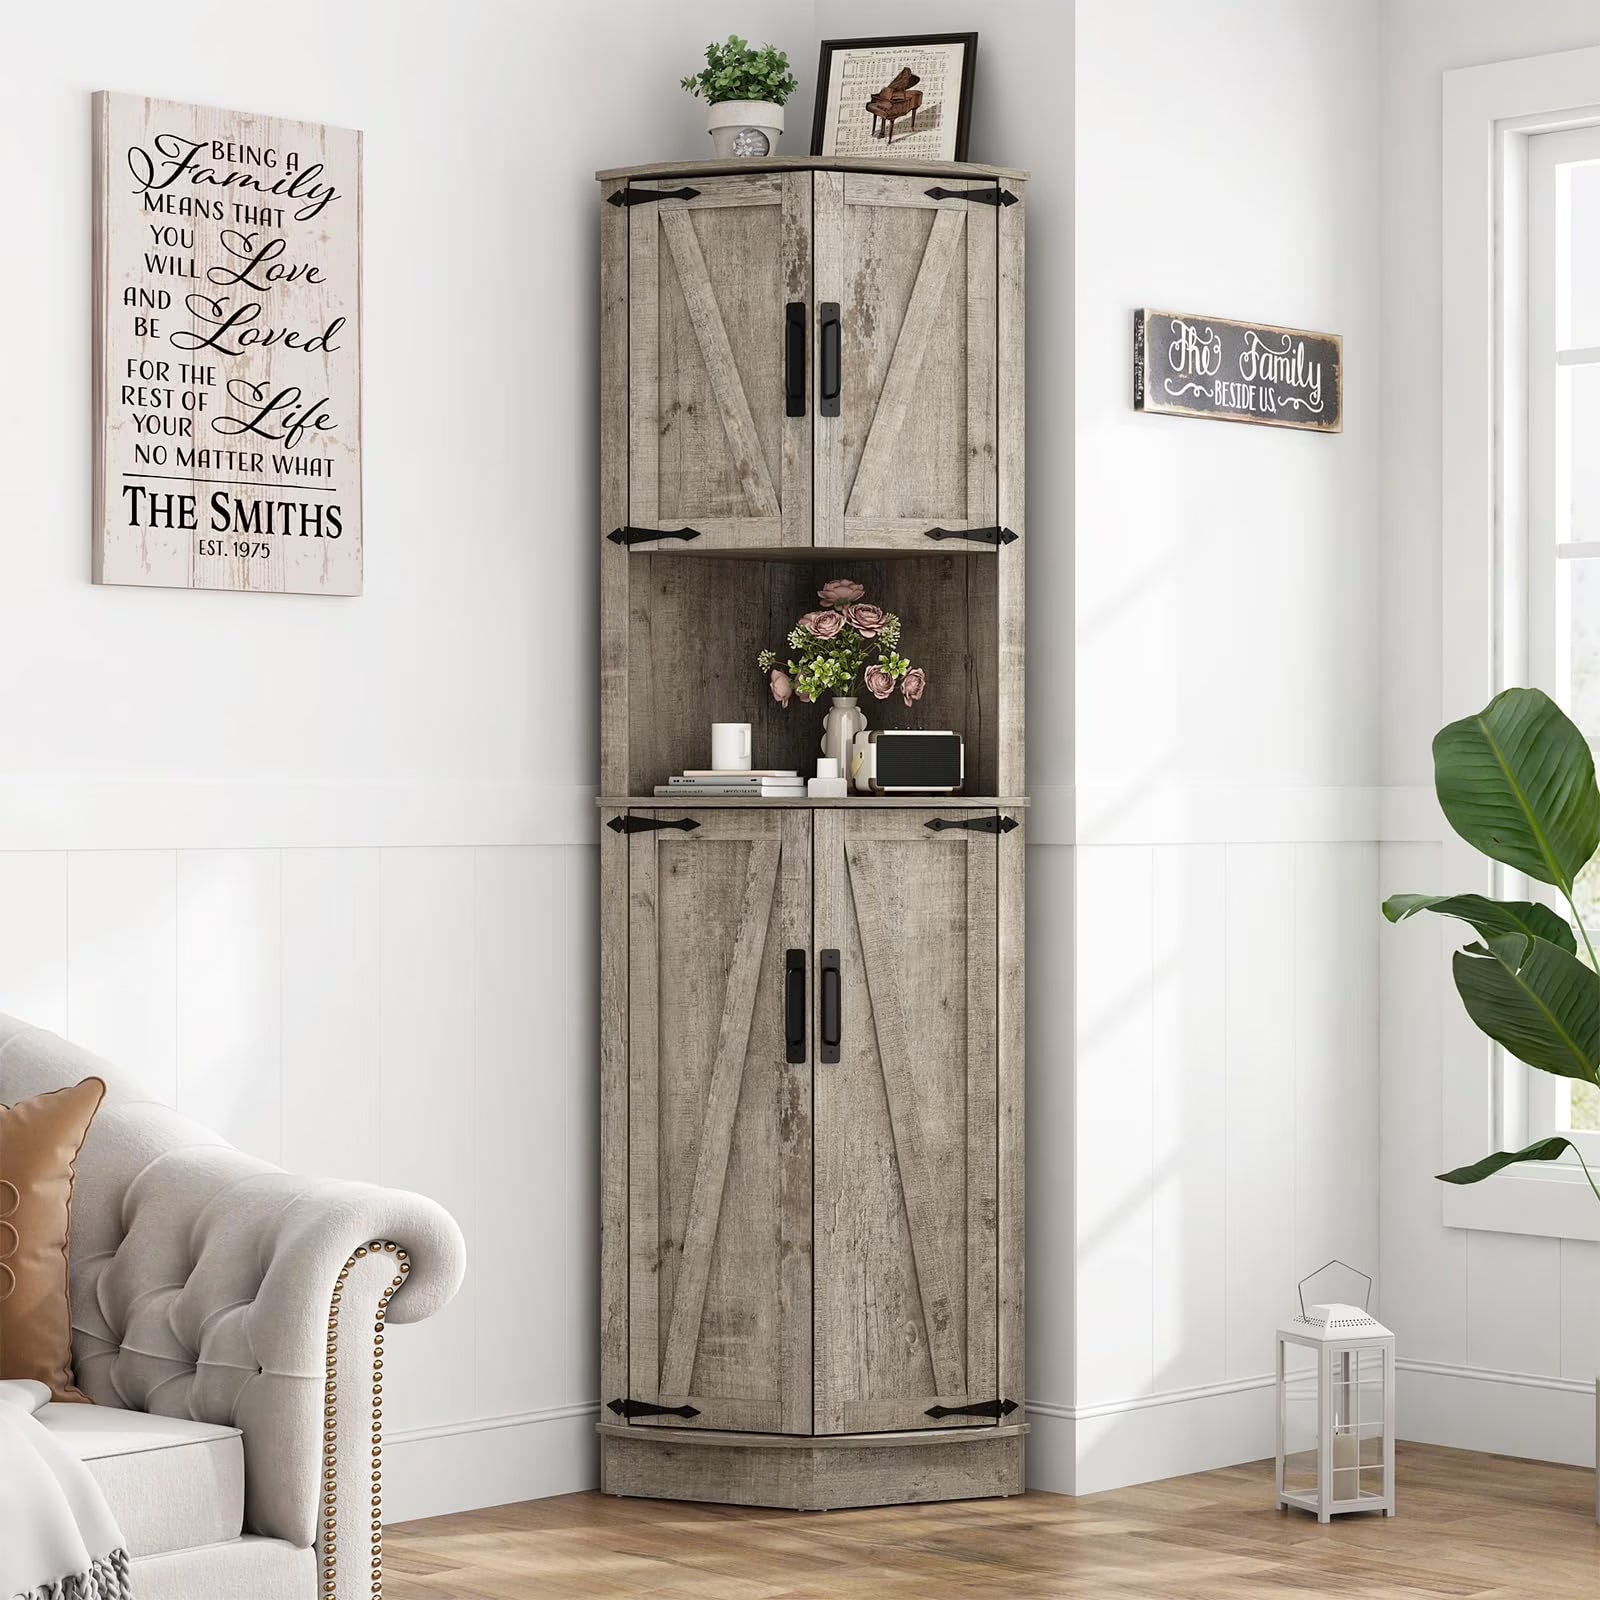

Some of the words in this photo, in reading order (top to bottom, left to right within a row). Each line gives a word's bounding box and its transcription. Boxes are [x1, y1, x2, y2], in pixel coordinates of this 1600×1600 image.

[211, 140, 277, 167] BEING
[286, 152, 299, 171] A
[127, 133, 342, 221] Family
[144, 191, 224, 221] MEANS
[232, 202, 285, 228] THAT
[150, 224, 194, 249] YOU
[144, 252, 201, 278] WILL
[207, 229, 327, 291] Love
[123, 286, 171, 310] AND
[134, 316, 161, 338] BE
[170, 293, 346, 356] Loved
[127, 358, 170, 382] FOR
[178, 363, 217, 386] THE
[1168, 319, 1222, 376] The
[1239, 330, 1321, 405] Family
[121, 385, 175, 409] REST
[181, 391, 208, 411] OF
[1214, 380, 1257, 411] BESIDE
[132, 413, 192, 437] YOUR
[211, 379, 338, 449] Life
[134, 444, 167, 465] NO
[176, 447, 263, 473] MATTER
[272, 454, 335, 478] WHAT
[122, 485, 198, 530] THE
[210, 491, 343, 539] SMITHS
[199, 539, 228, 557] EST.
[233, 541, 270, 559] 1975
